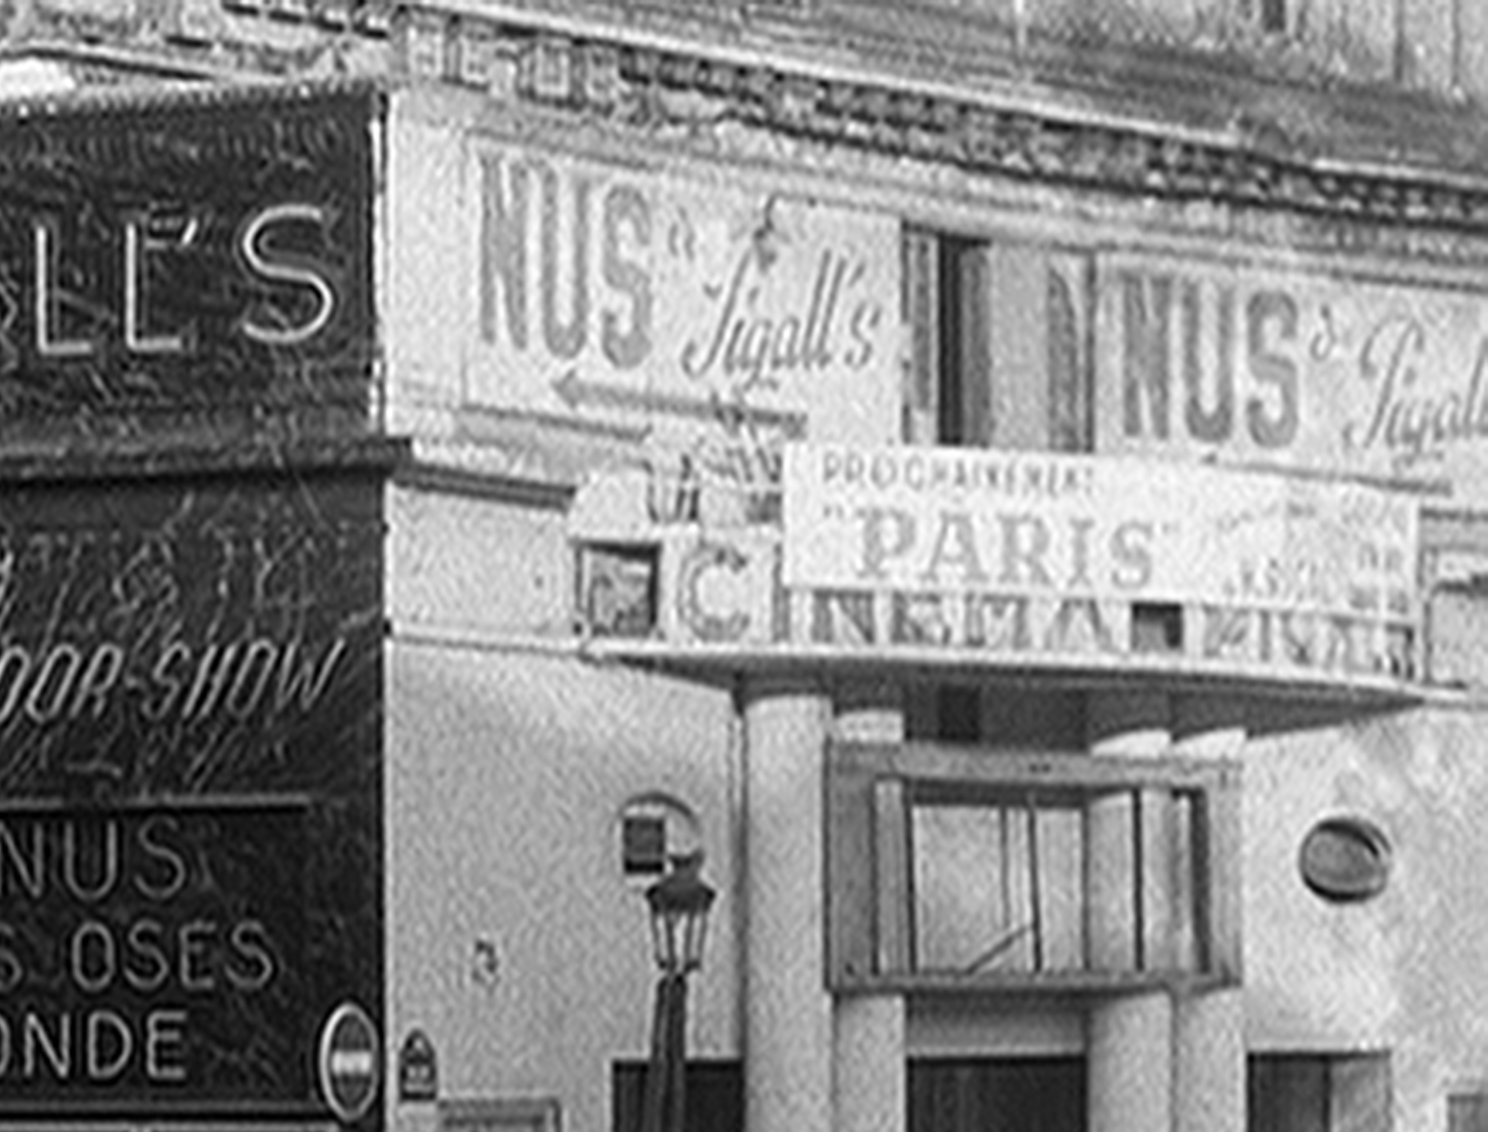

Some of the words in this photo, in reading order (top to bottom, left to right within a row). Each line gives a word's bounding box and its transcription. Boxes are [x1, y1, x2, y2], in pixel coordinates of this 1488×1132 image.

[478, 153, 656, 371] NUS
[1121, 272, 1302, 450] NUS
[68, 918, 280, 992] OSES
